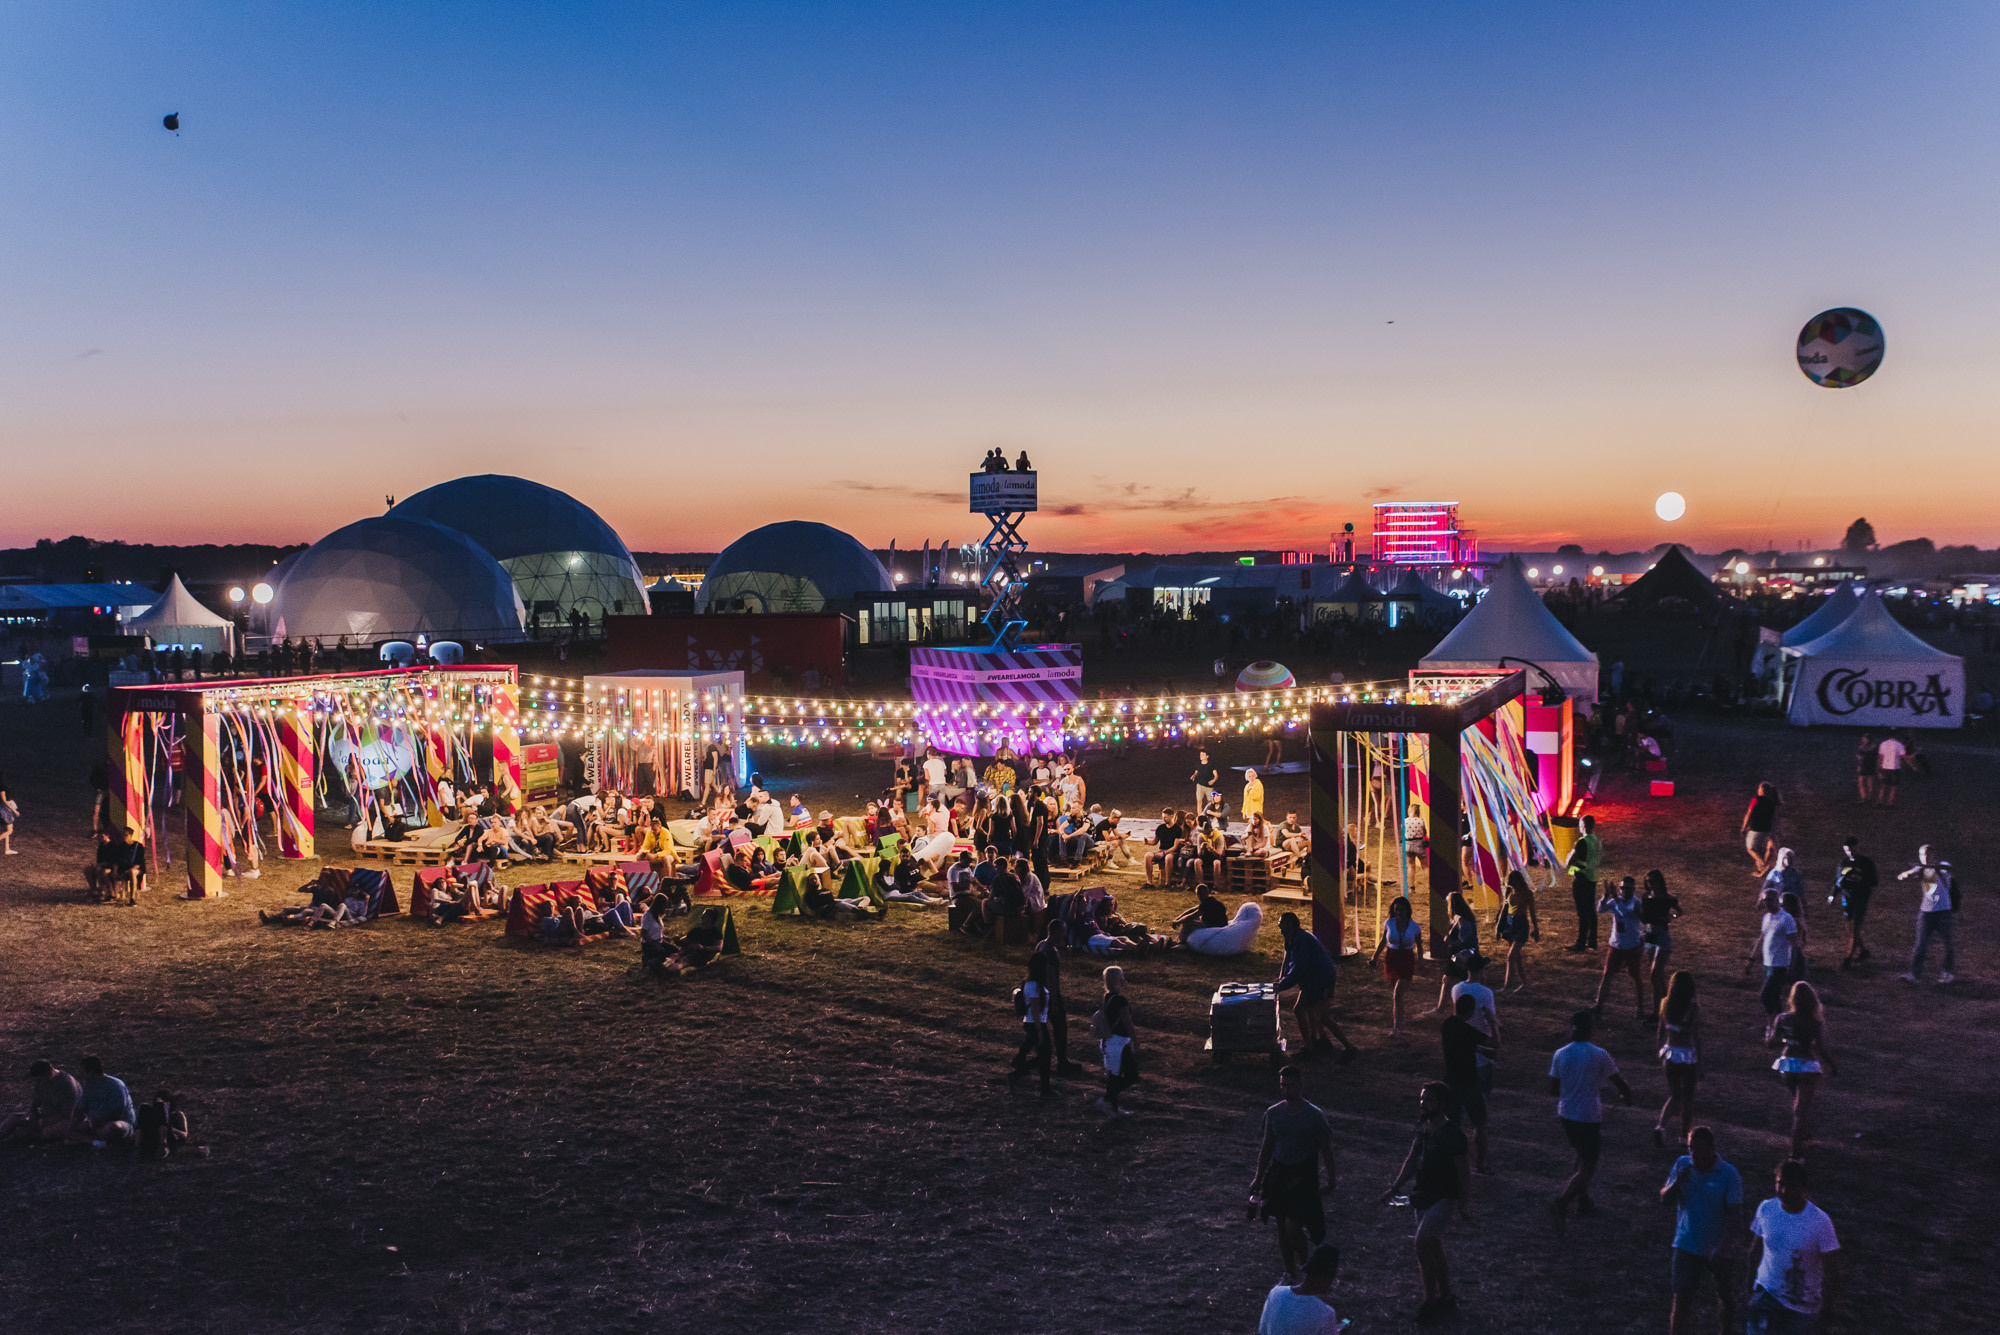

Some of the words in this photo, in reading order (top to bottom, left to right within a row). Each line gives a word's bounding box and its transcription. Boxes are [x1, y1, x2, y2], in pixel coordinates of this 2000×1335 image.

[972, 477, 1000, 494] lamoda
[1004, 480, 1035, 489] lamoda
[1047, 669, 1075, 677] lamoda
[1816, 668, 1952, 716] COBRA
[1345, 708, 1417, 727] lamoda
